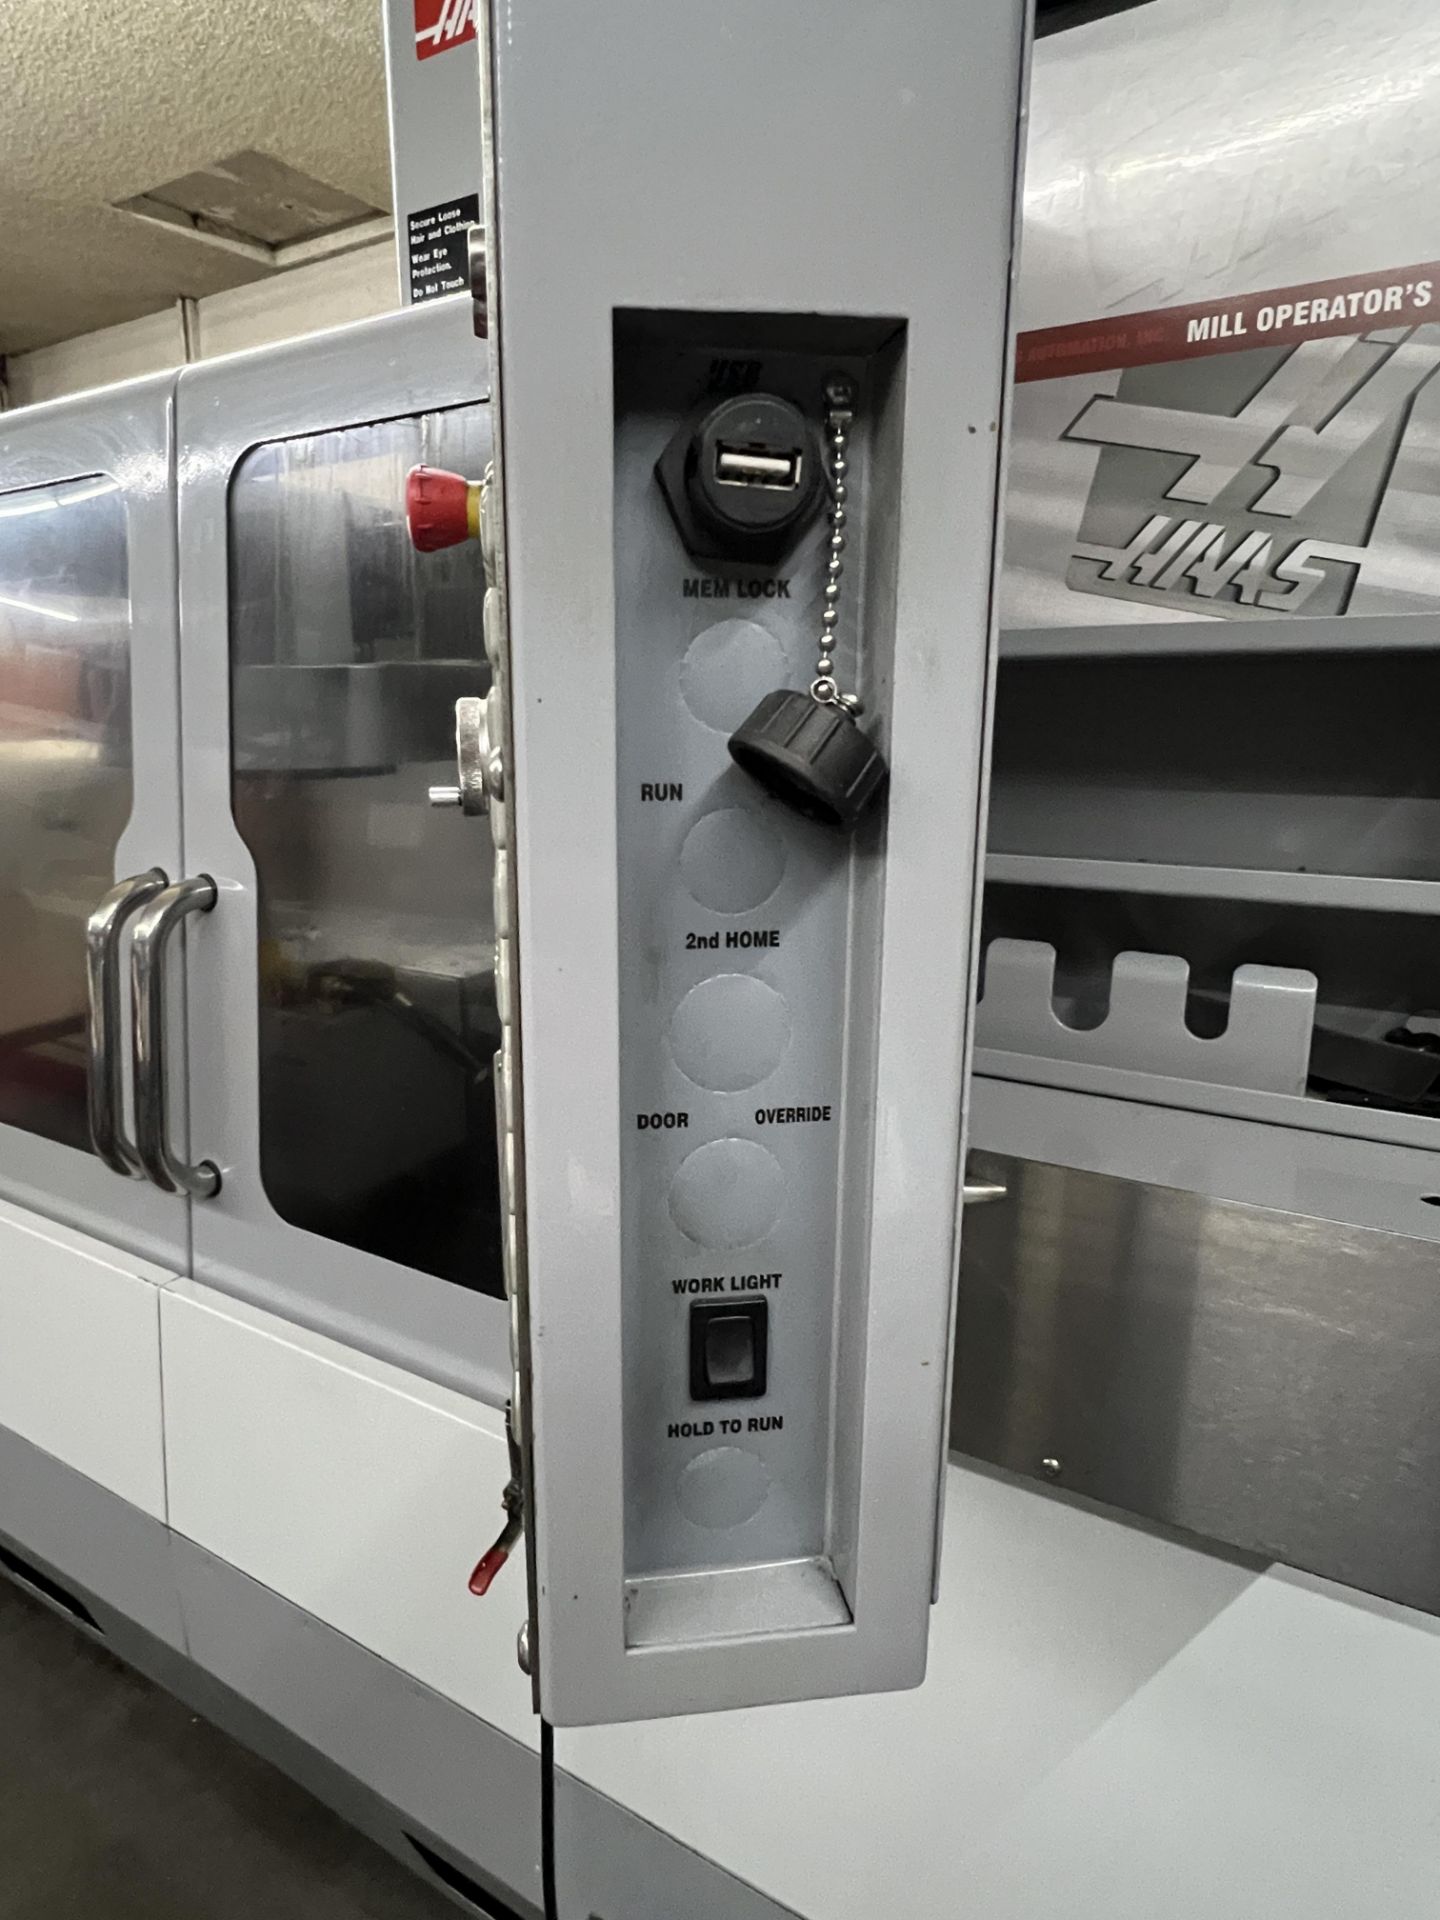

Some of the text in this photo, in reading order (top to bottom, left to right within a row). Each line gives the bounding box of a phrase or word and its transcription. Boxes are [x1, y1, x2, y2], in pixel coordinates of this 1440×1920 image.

[410, 208, 461, 231] Secure Loose
[410, 233, 425, 245] Hair
[428, 227, 442, 240] and
[411, 248, 448, 264] Wear Eye
[413, 276, 465, 298] Do Not Touch
[1187, 281, 1433, 342] MILL OPERATOR'S
[1072, 514, 1362, 612] HAAS
[683, 579, 791, 599] MEM LOCK
[641, 783, 683, 802] RUN
[686, 929, 780, 949] 2nd HOME
[637, 1105, 831, 1130] DOOR OVERRIDE
[672, 1273, 782, 1294] WORK LIGHT
[667, 1415, 783, 1438] HOLD TO RUN
